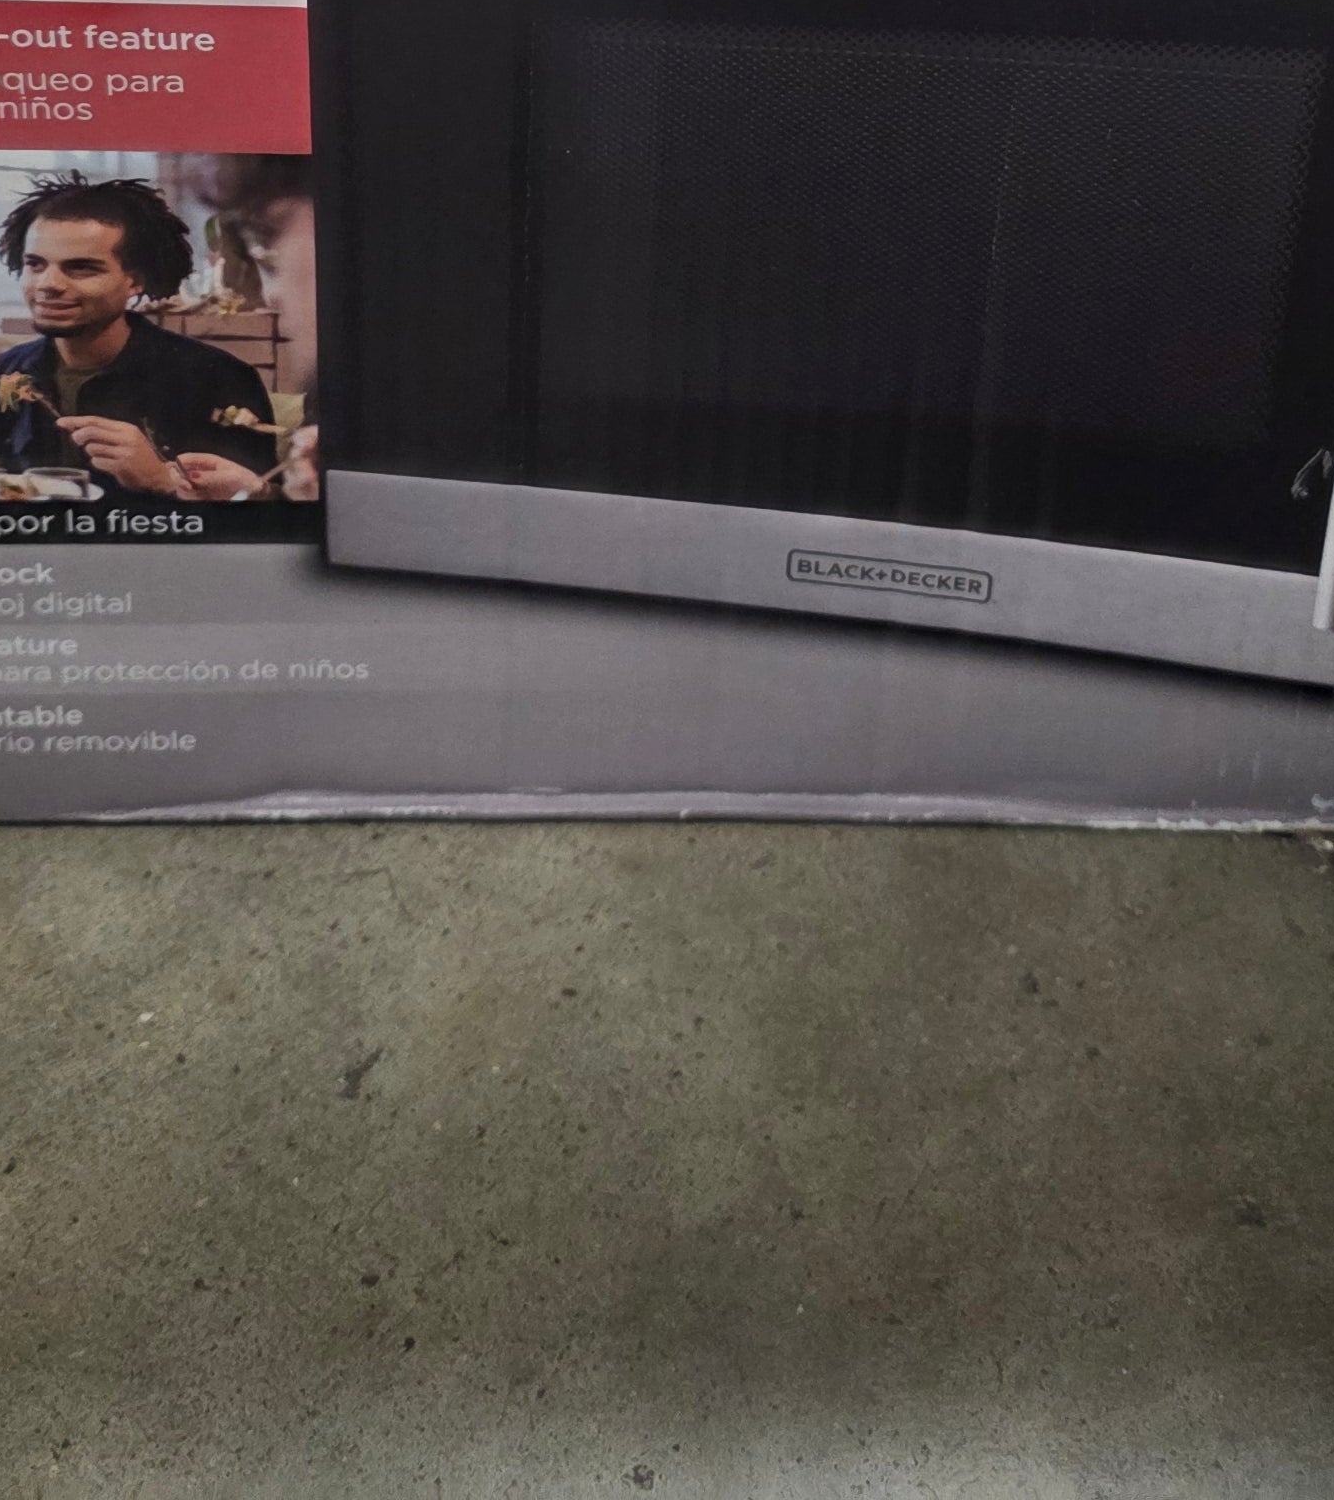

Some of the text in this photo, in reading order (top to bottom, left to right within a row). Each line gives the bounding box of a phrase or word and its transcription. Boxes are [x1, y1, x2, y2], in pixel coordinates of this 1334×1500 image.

[83, 24, 216, 52] feature
[106, 72, 185, 97] para
[65, 509, 96, 534] la
[107, 508, 204, 535] fiesta
[796, 557, 983, 596] BLACK+DECKER
[34, 591, 133, 619] digital
[60, 659, 230, 685] protección
[239, 658, 279, 680] de
[288, 658, 369, 680] niños
[43, 729, 197, 753] removible
